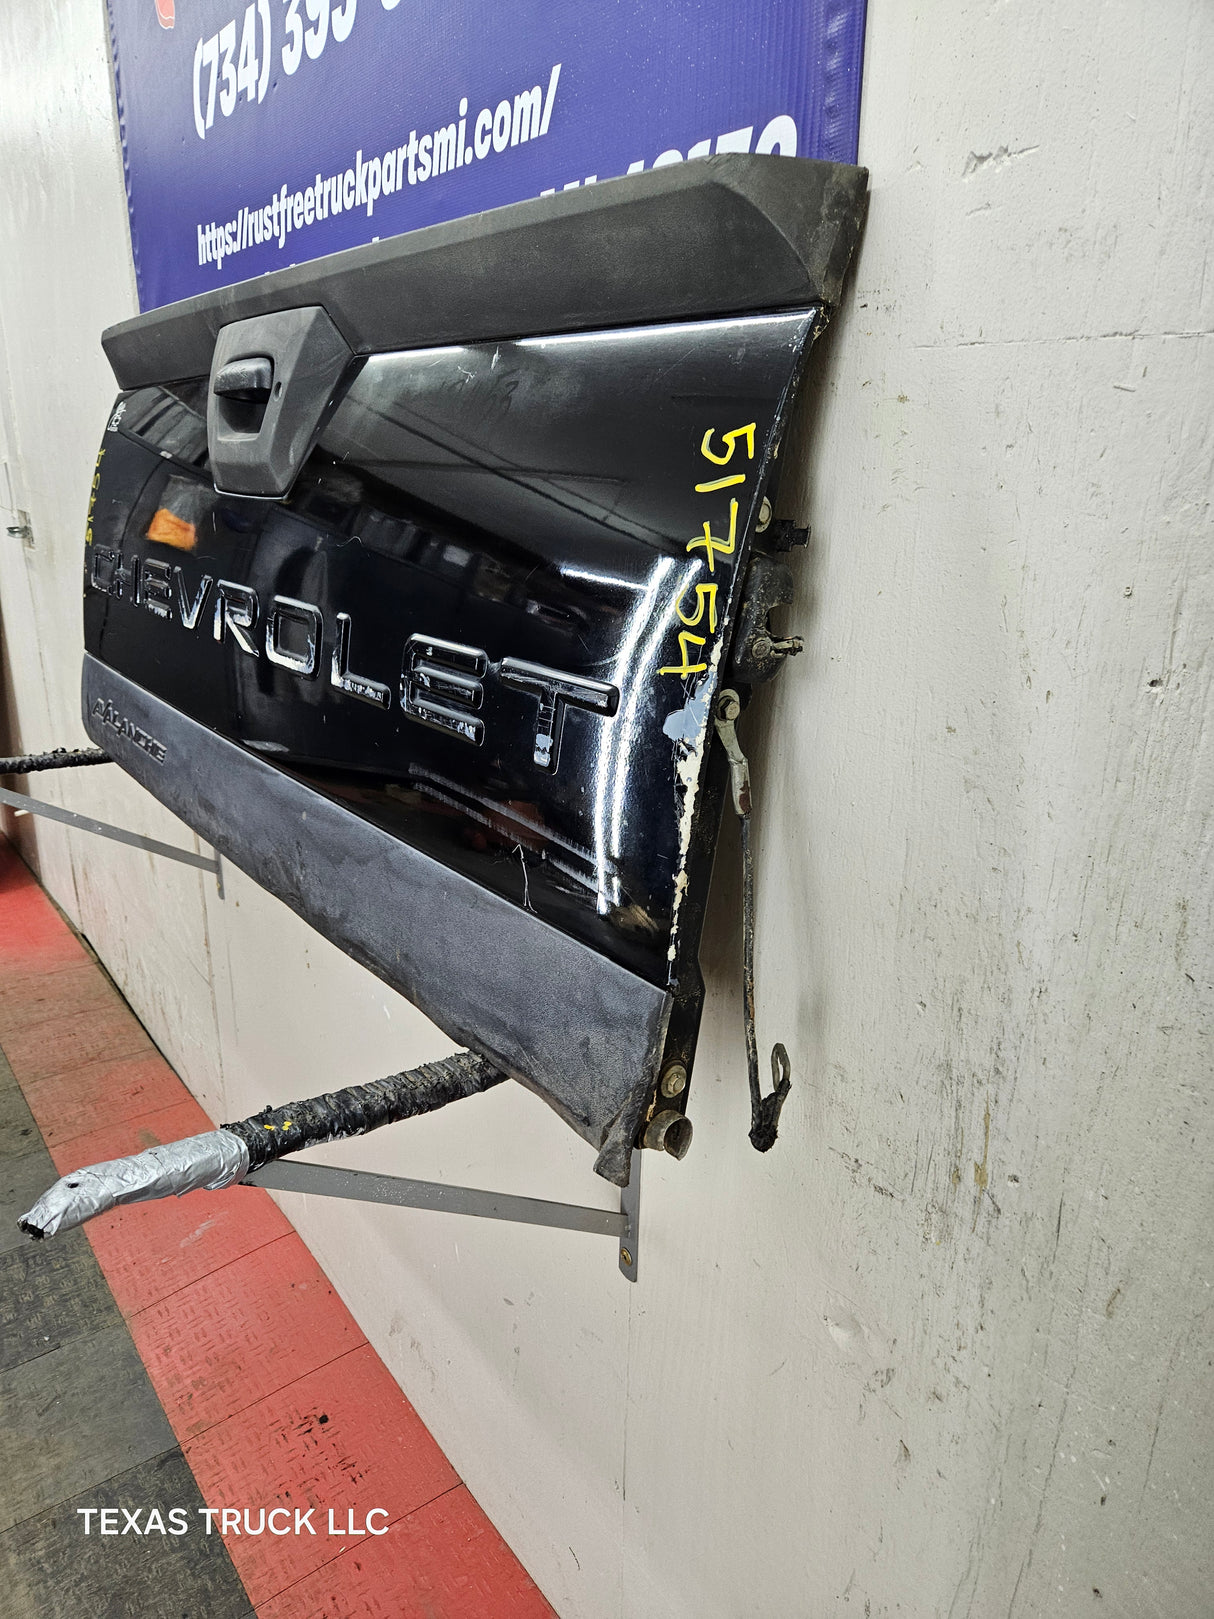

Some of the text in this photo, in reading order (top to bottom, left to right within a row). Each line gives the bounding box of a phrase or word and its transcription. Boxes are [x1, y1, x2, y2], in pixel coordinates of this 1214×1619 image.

[193, 0, 271, 139] (734)
[197, 63, 561, 269] https://rustfreetruckpartsmi.com/
[657, 422, 756, 679] 51754
[91, 544, 620, 776] CHEVROLET
[92, 698, 167, 766] AVALANCHE
